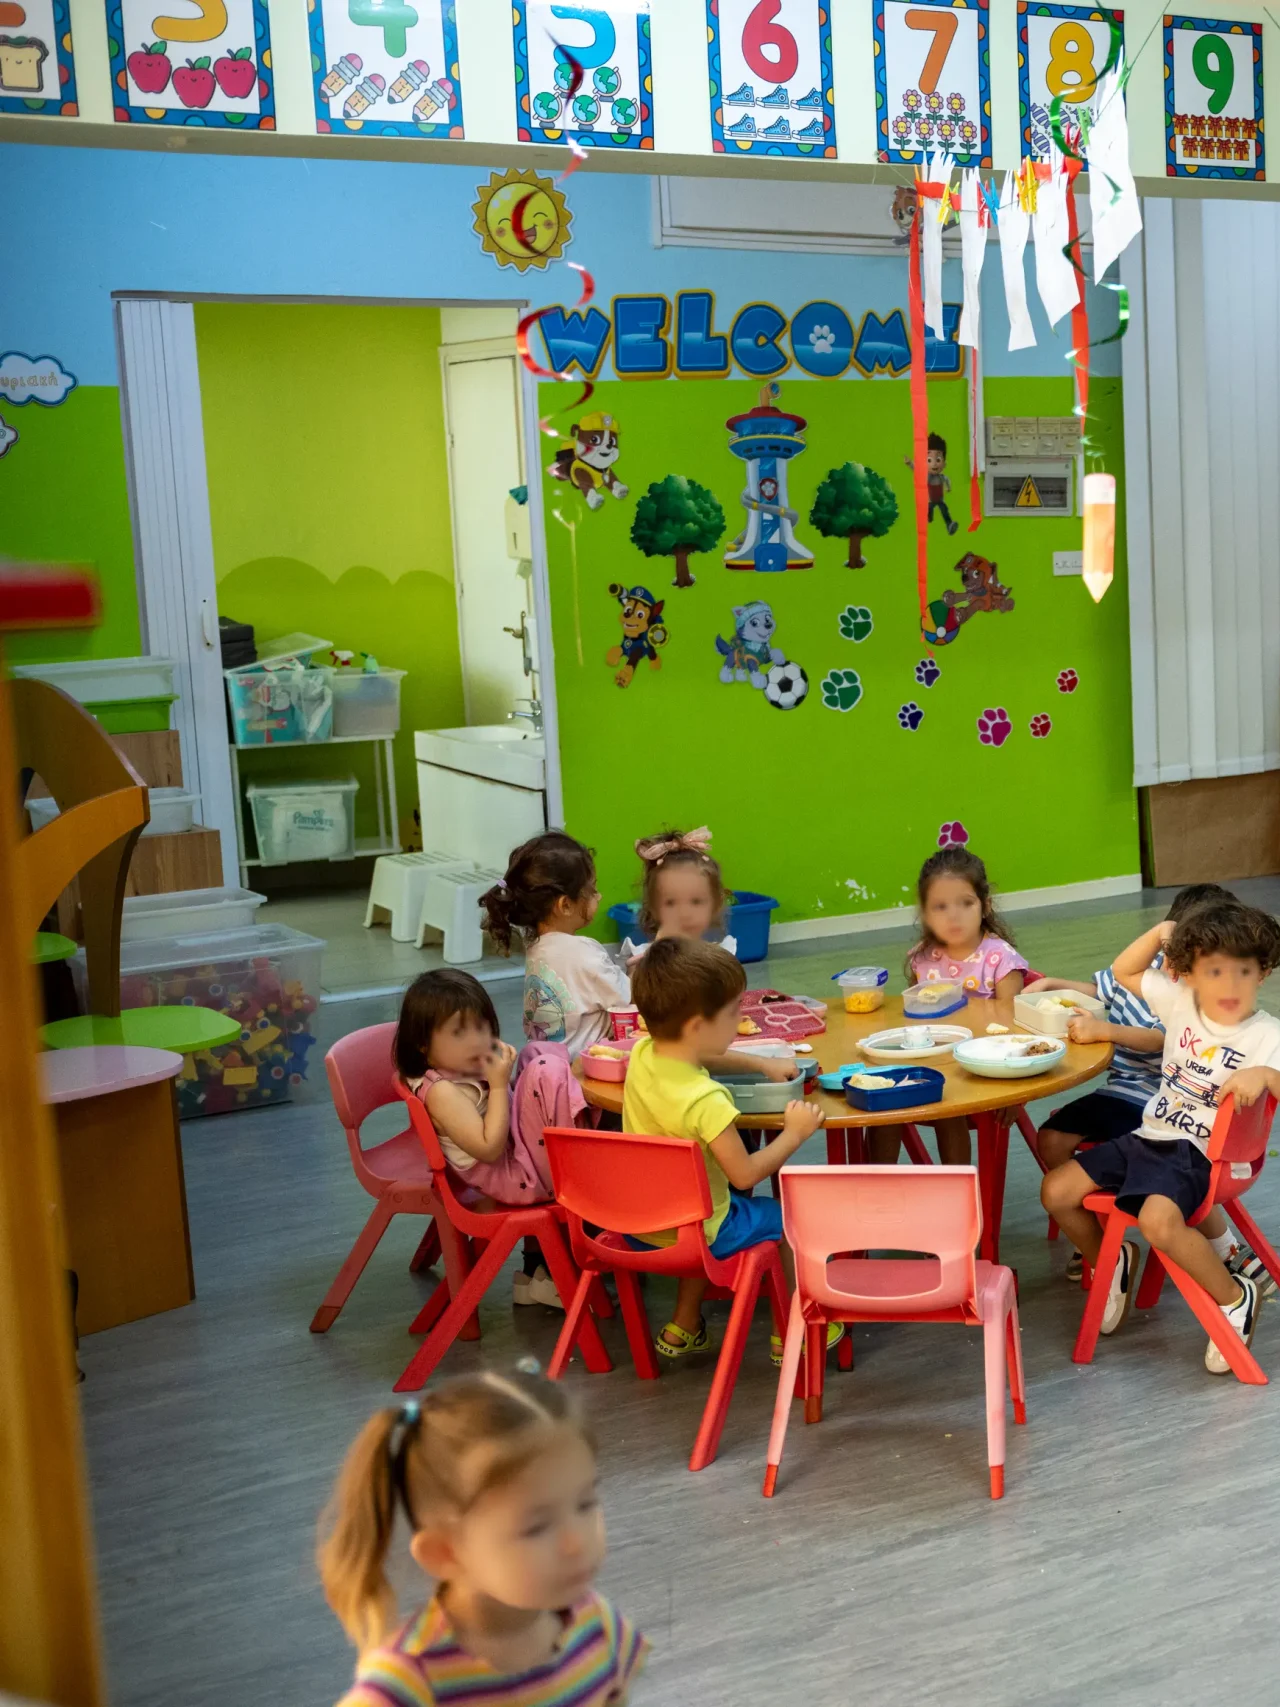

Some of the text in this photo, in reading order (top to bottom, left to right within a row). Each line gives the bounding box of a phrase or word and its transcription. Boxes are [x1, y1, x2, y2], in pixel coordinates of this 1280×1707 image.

[742, 0, 798, 84] 6
[905, 9, 958, 95] 7
[1046, 21, 1097, 104] 8
[1192, 33, 1234, 114] 9
[0, 372, 58, 391] υριακή
[1179, 1026, 1246, 1070] SKATE
